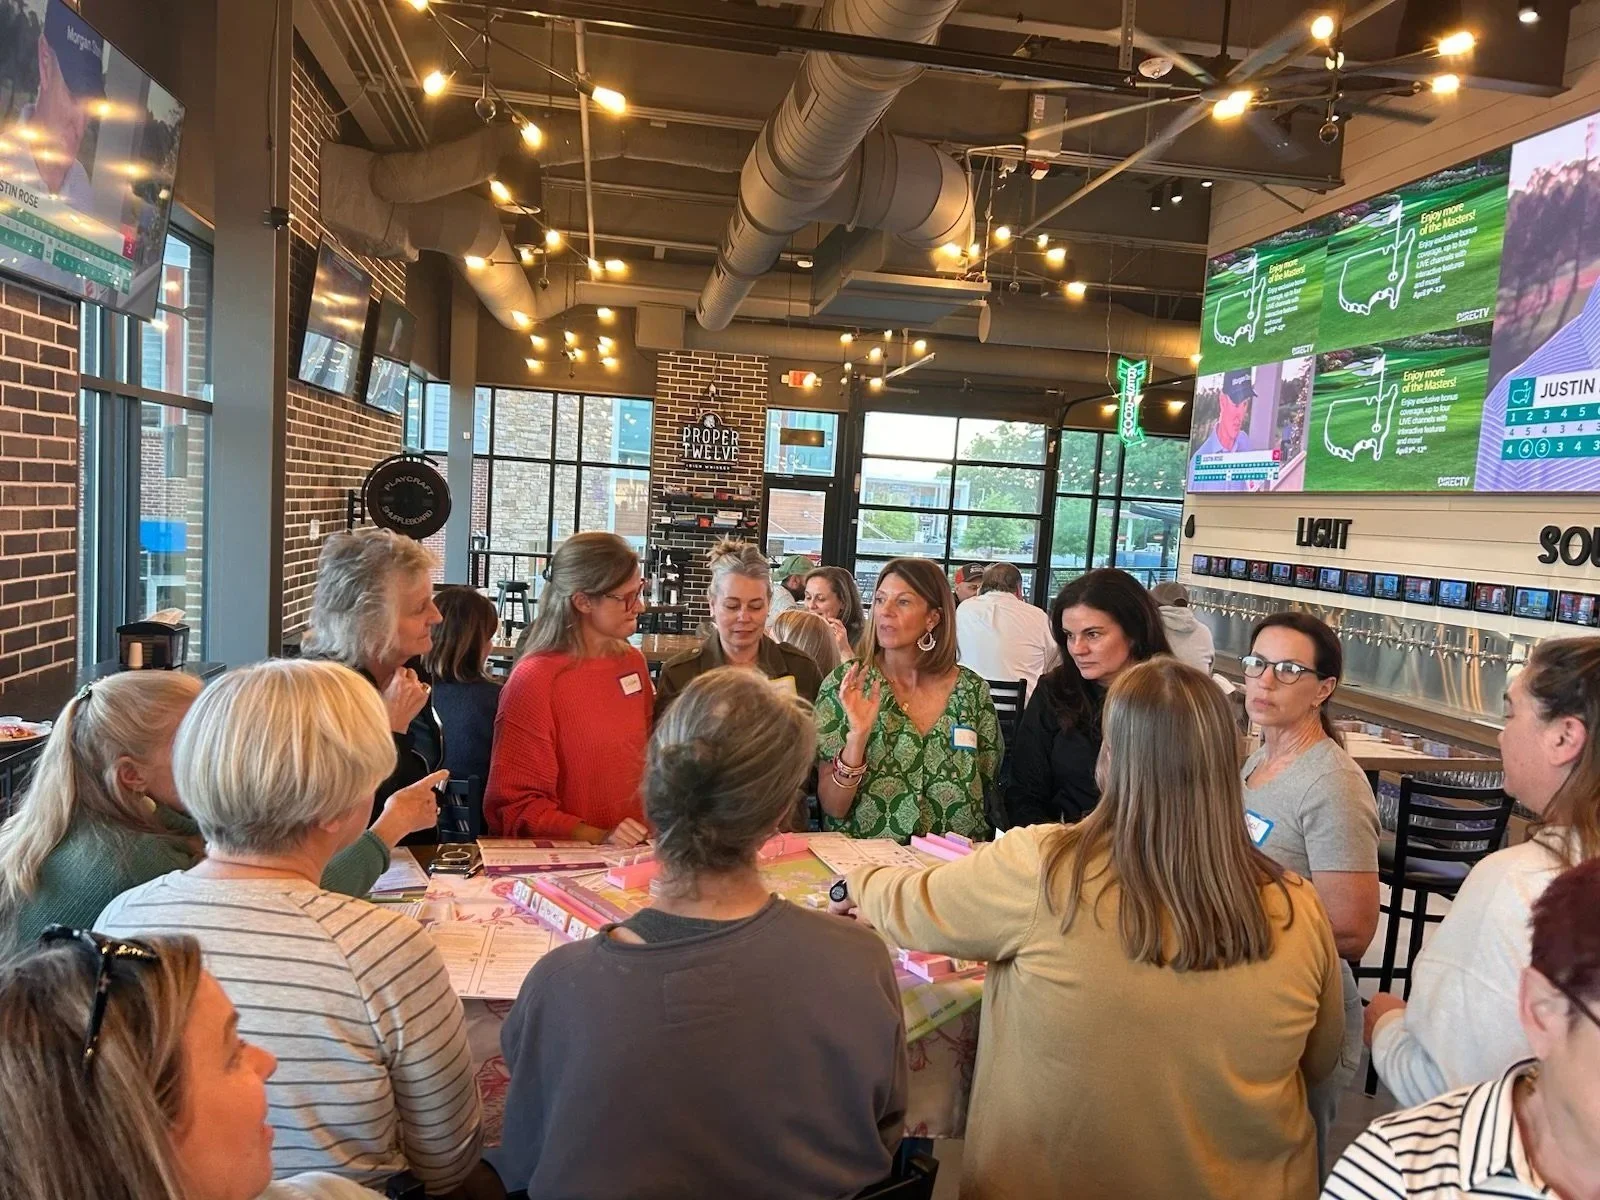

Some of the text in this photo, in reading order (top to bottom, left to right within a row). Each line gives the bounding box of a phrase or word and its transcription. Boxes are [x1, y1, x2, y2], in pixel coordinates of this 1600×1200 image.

[67, 25, 91, 50] Morgan
[18, 188, 39, 208] ROSE
[1421, 203, 1464, 224] Enjoy more
[1419, 209, 1476, 236] of the Masters!
[1418, 227, 1477, 250] Enjoy exclusive bonus
[1443, 244, 1452, 253] up
[1451, 241, 1458, 249] to
[1457, 238, 1470, 248] four
[1416, 258, 1429, 269] LIVE
[1453, 249, 1467, 259] with
[1442, 261, 1465, 272] features
[1269, 264, 1283, 274] Enjoy
[1413, 289, 1426, 300] April
[1456, 308, 1489, 321] DIRECTV
[1403, 368, 1446, 384] Enjoy more
[1402, 377, 1457, 394] of the Masters!
[1540, 378, 1595, 398] JUSTIN
[1401, 393, 1459, 407] Enjoy exclusive bonus
[1425, 407, 1433, 415] up
[1440, 404, 1452, 412] four
[1511, 407, 1585, 422] 1 2 3 4 5
[1399, 417, 1412, 425] LIVE
[1436, 414, 1449, 423] with
[682, 427, 739, 446] PROPER
[1423, 425, 1446, 433] features
[1526, 427, 1531, 435] 5
[1542, 426, 1547, 434] 4
[1560, 425, 1565, 433] 3
[682, 443, 739, 462] TWELVE
[1396, 447, 1409, 456] April
[1506, 440, 1600, 454] 4 4 3 3 4 3
[384, 476, 434, 496] PLAYCRAFT
[1438, 476, 1470, 487] DIRECTV
[1296, 517, 1352, 549] LIGHT
